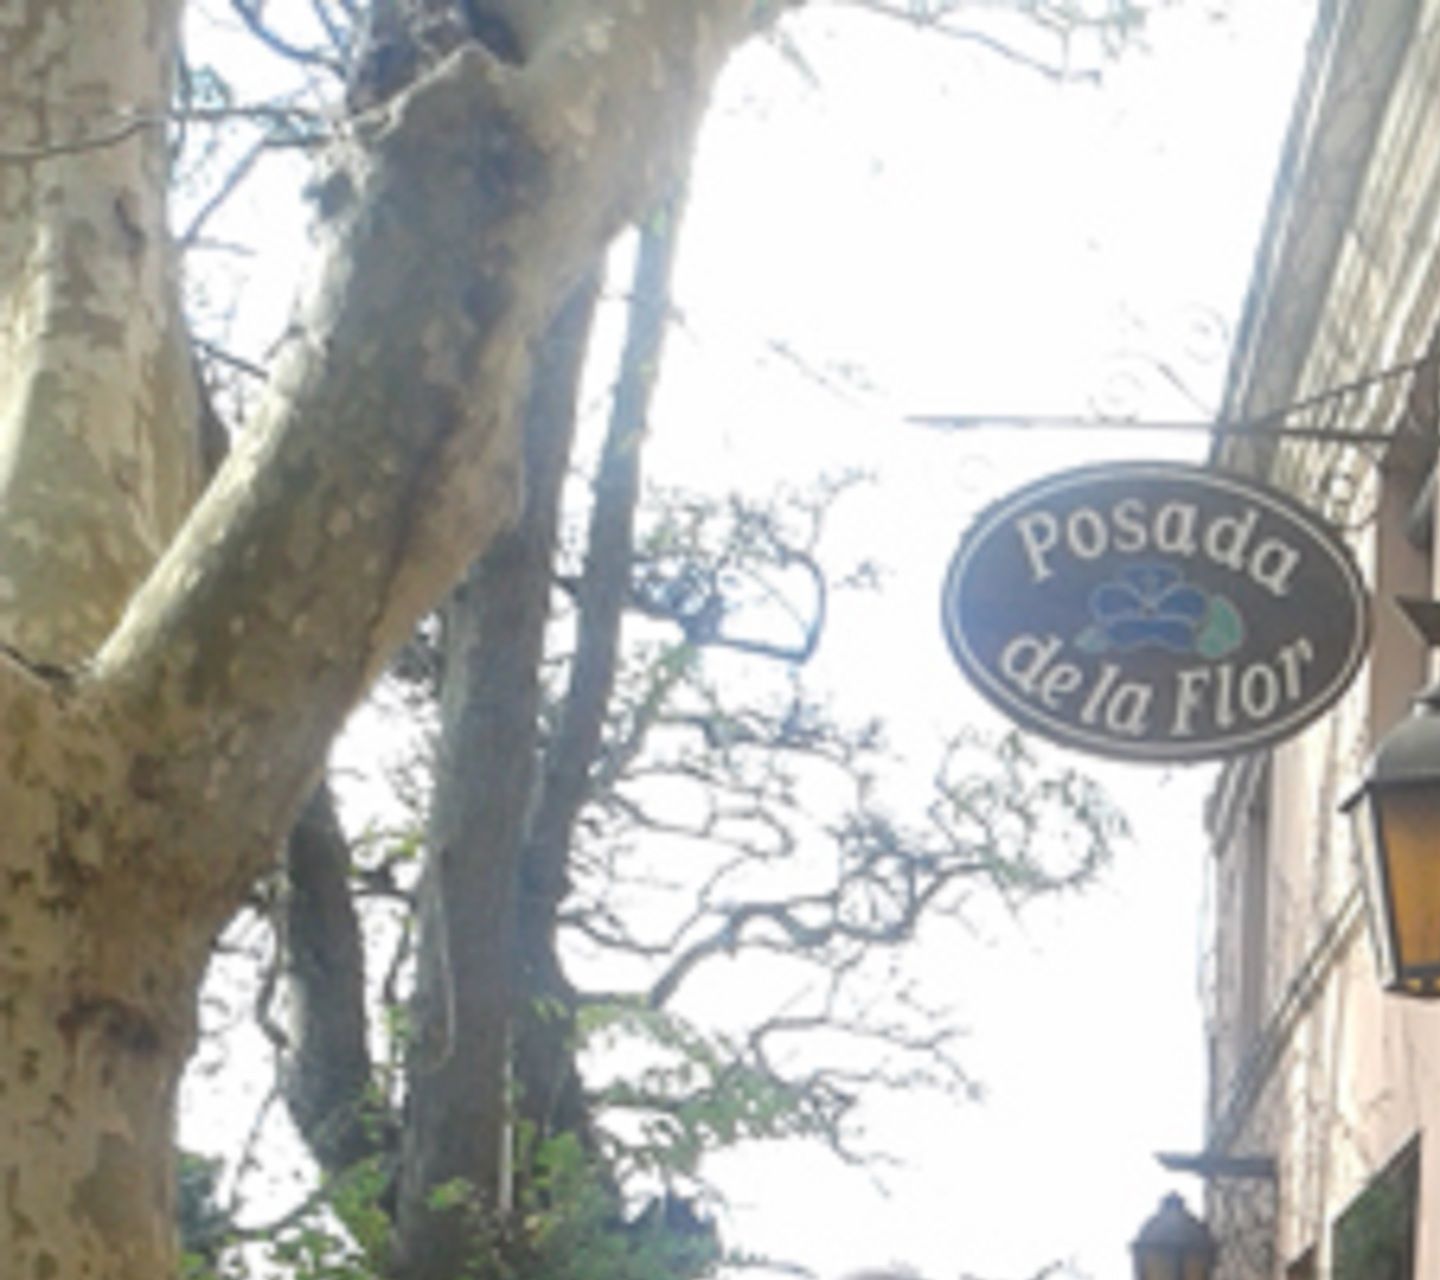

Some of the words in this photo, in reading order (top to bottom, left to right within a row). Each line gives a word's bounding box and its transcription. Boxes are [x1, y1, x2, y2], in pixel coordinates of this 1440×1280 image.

[1016, 497, 1301, 597] Posada
[999, 631, 1084, 708] de
[1080, 664, 1154, 737] la
[1170, 636, 1315, 738] Flor
